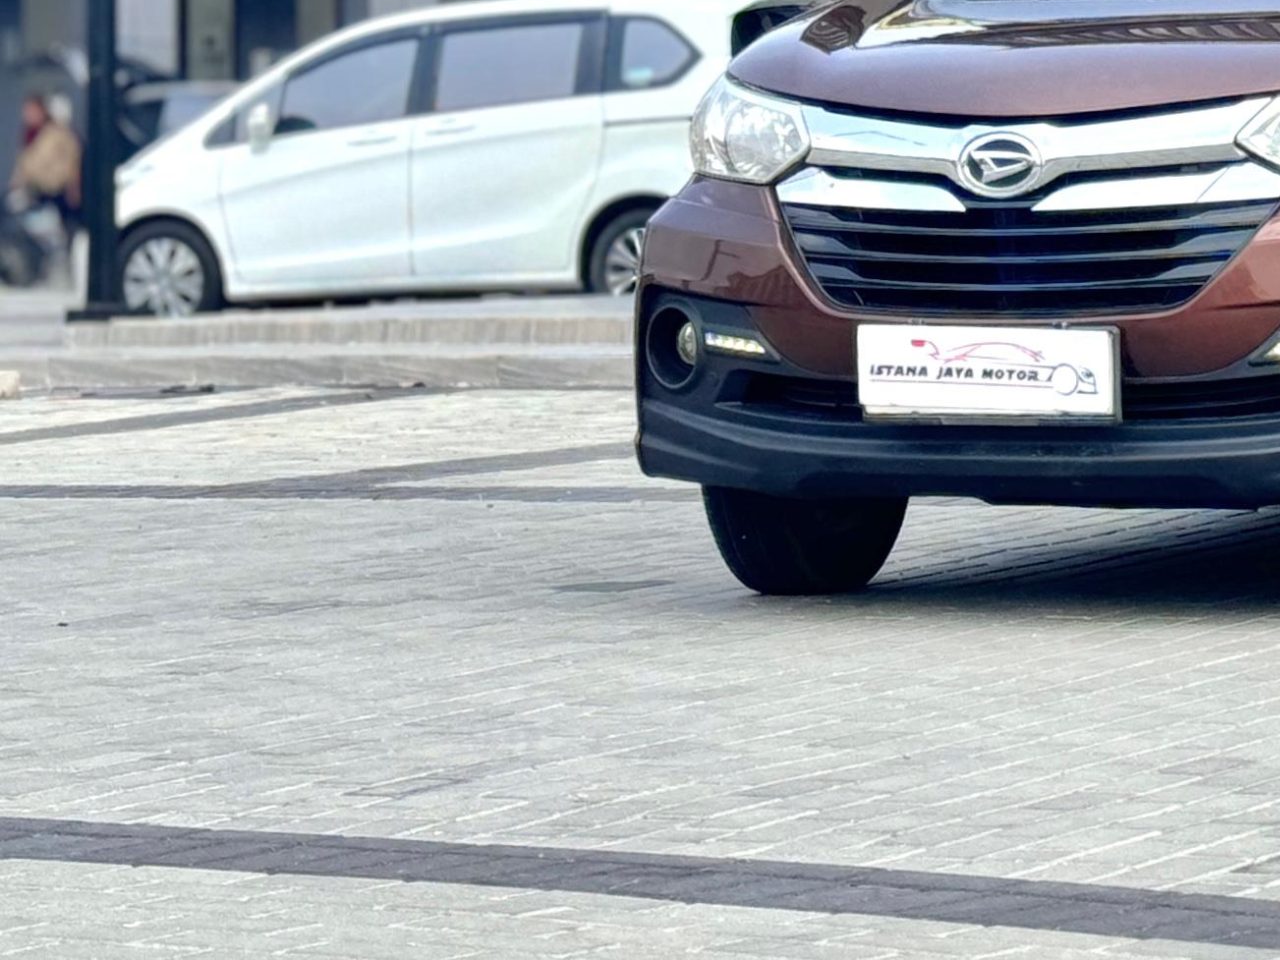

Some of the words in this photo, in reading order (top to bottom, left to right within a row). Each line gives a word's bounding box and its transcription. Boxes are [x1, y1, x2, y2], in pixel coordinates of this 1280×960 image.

[869, 364, 928, 378] ISTANA
[936, 366, 974, 380] JAYA
[981, 367, 1040, 382] MOTOR
